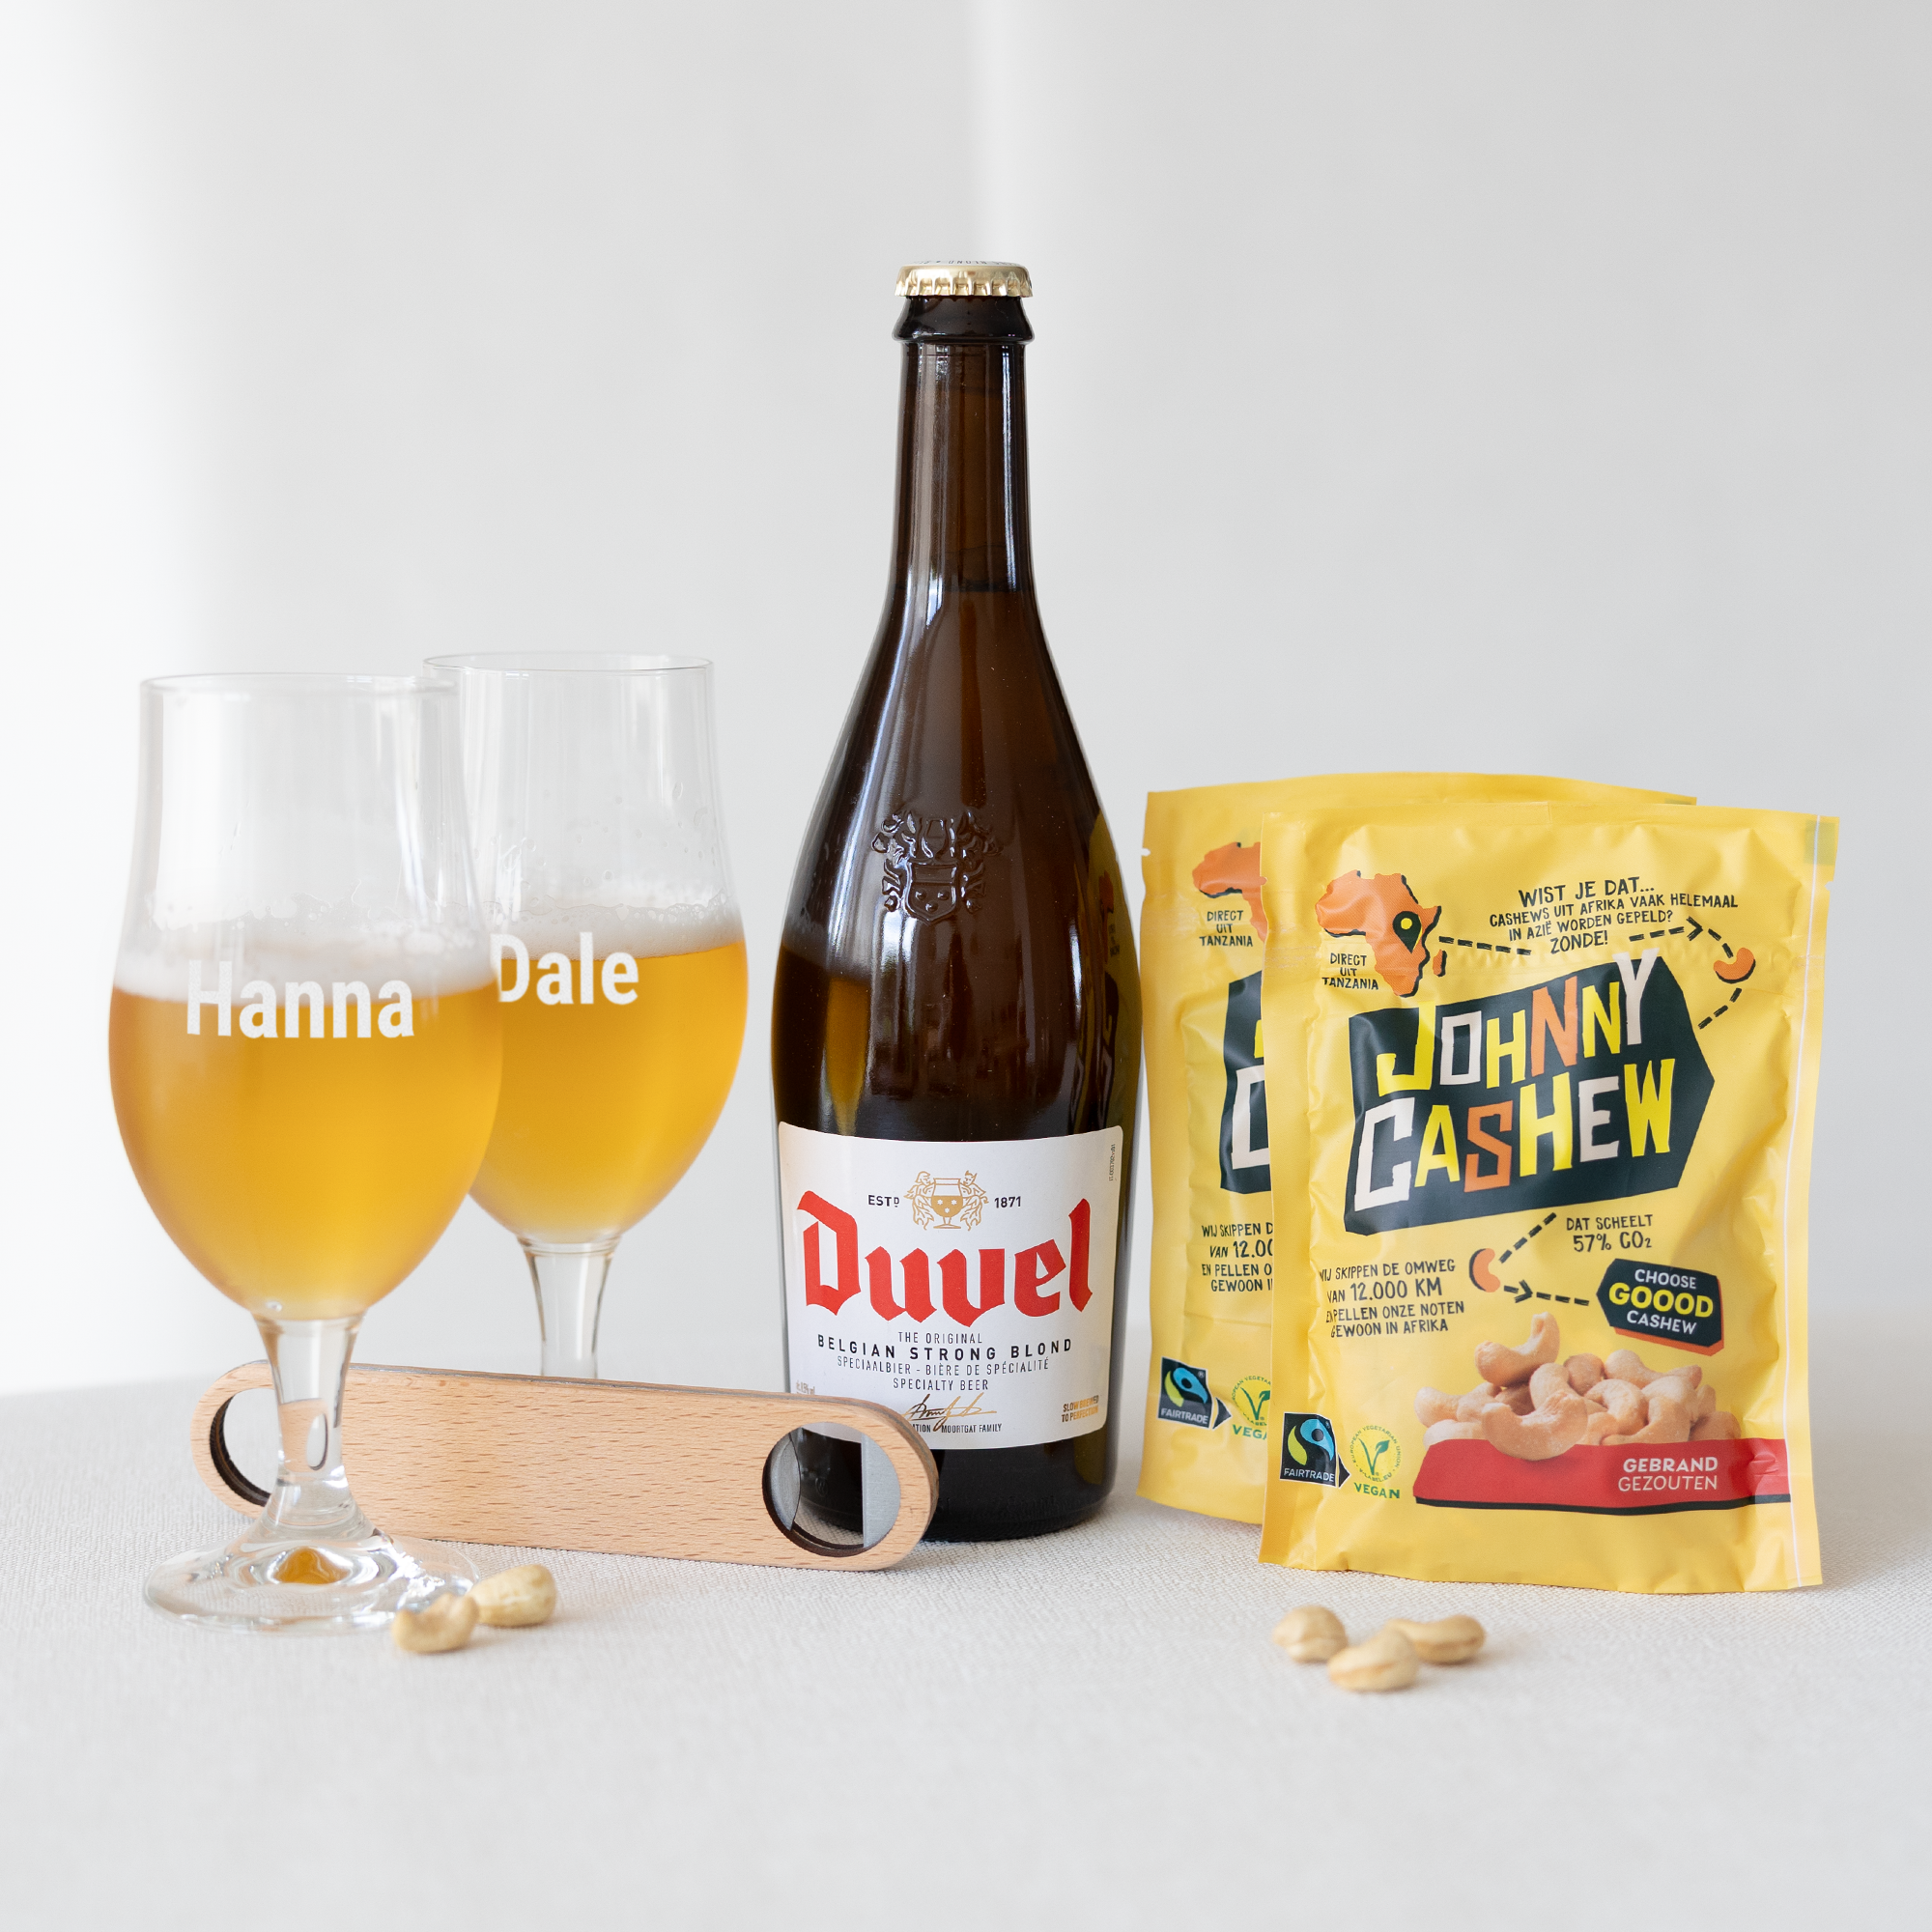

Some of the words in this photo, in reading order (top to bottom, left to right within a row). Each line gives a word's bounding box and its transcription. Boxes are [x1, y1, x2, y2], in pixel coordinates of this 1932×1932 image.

[1519, 885, 1566, 907] WIST
[1576, 881, 1596, 899] JE
[1605, 877, 1655, 895] DAT...
[1208, 910, 1242, 922] DIRECT
[1490, 904, 1549, 927] CASHEWS
[1554, 904, 1574, 918] UIT
[1579, 898, 1625, 916] AFRIKA
[1630, 895, 1665, 908] VAAK
[1670, 893, 1739, 908] HELEMAAL
[1216, 923, 1233, 934] UIT
[1509, 928, 1521, 942] IN
[1526, 922, 1551, 940] AZIË
[1557, 915, 1611, 933] WORDEN
[1617, 910, 1673, 924] GEPELD?
[1199, 935, 1253, 948] TANZANIA
[1550, 930, 1608, 954] ZONDE!
[1330, 952, 1367, 967] DIRECT
[489, 932, 639, 1006] Dale
[1340, 967, 1357, 978] UIT
[1321, 976, 1378, 991] TANZANIA
[186, 959, 414, 1038] Hanna
[1376, 948, 1660, 1096] JOHNNY
[1354, 1058, 1675, 1211] CASHEW
[994, 1196, 1021, 1208] 1871
[1202, 1224, 1217, 1237] WIJ
[1220, 1222, 1261, 1237] SKIPPEN
[1266, 1222, 1273, 1235] D
[1566, 1217, 1590, 1231] DAT
[1596, 1214, 1653, 1230] SCHEELT
[1209, 1245, 1228, 1258] VAN
[1573, 1234, 1611, 1253] 57%
[797, 1190, 1093, 1327] Duvel
[1202, 1264, 1211, 1276] EN
[1214, 1264, 1259, 1277] PELLEN
[1335, 1264, 1378, 1280] SKIPPEN
[1383, 1263, 1400, 1276] DE
[1405, 1259, 1456, 1275] OMWEG
[1211, 1279, 1263, 1292] GEWOON
[1267, 1279, 1273, 1291] I
[1634, 1268, 1696, 1290] CHOOSE
[1326, 1290, 1346, 1303] VAN
[1350, 1280, 1407, 1301] 12.000
[1415, 1276, 1442, 1297] KM
[1608, 1282, 1714, 1318] GOOOD
[1382, 1304, 1415, 1320] ONZE
[1420, 1300, 1465, 1317] NOTEN
[1330, 1322, 1381, 1338] GEWOON
[1385, 1321, 1398, 1334] IN
[1404, 1319, 1449, 1334] AFRIKA
[1627, 1310, 1697, 1334] CASHEW
[817, 1333, 895, 1358] BELGIAN
[909, 1347, 996, 1361] STRONG
[1010, 1338, 1071, 1359] BLOND
[897, 1331, 919, 1343] THE
[925, 1332, 982, 1345] ORIGINAL
[837, 1355, 911, 1375] SPECIAALBIER
[925, 1362, 960, 1376] BIÈRE
[966, 1364, 980, 1376] DE
[986, 1356, 1049, 1376] SPÉCIALITÉ
[893, 1378, 954, 1390] SPECIALTY
[959, 1378, 989, 1390] BEER
[1161, 1407, 1208, 1425] FAIRTRADE
[941, 1424, 977, 1434] MOORTGAT
[979, 1423, 1003, 1433] FAMILY
[1623, 1456, 1719, 1474] GEBRAND
[1283, 1467, 1335, 1483] FAIRTRADE
[1618, 1474, 1718, 1492] GEZOUTEN
[1353, 1482, 1400, 1498] VEGAN
